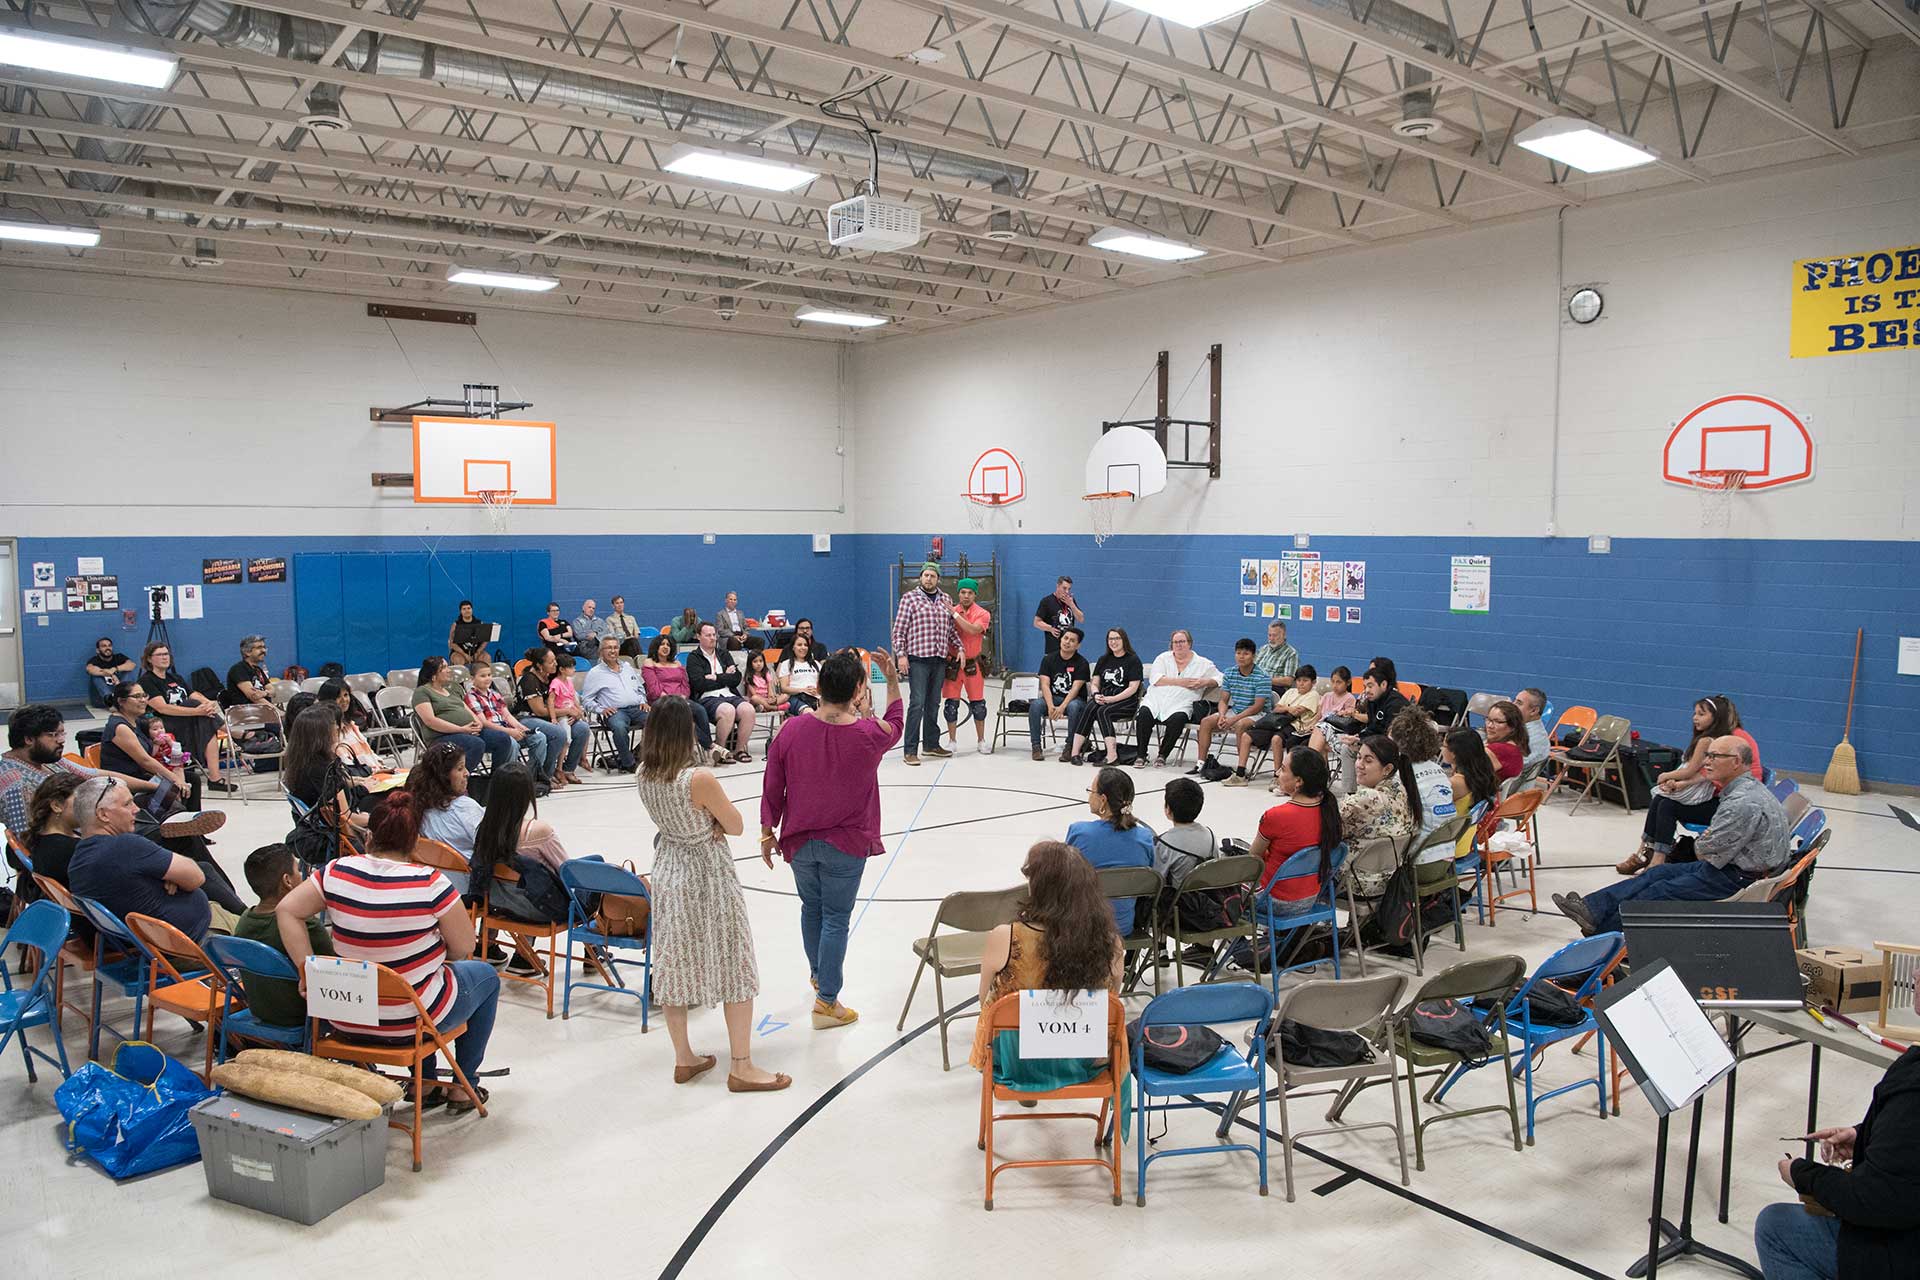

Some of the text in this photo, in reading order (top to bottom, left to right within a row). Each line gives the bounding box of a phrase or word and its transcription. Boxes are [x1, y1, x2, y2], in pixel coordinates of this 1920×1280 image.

[1844, 289, 1920, 315] IS T
[319, 987, 364, 1004] VOM 4
[1700, 986, 1739, 1001] CSF
[1038, 1022, 1091, 1034] VOM 4
